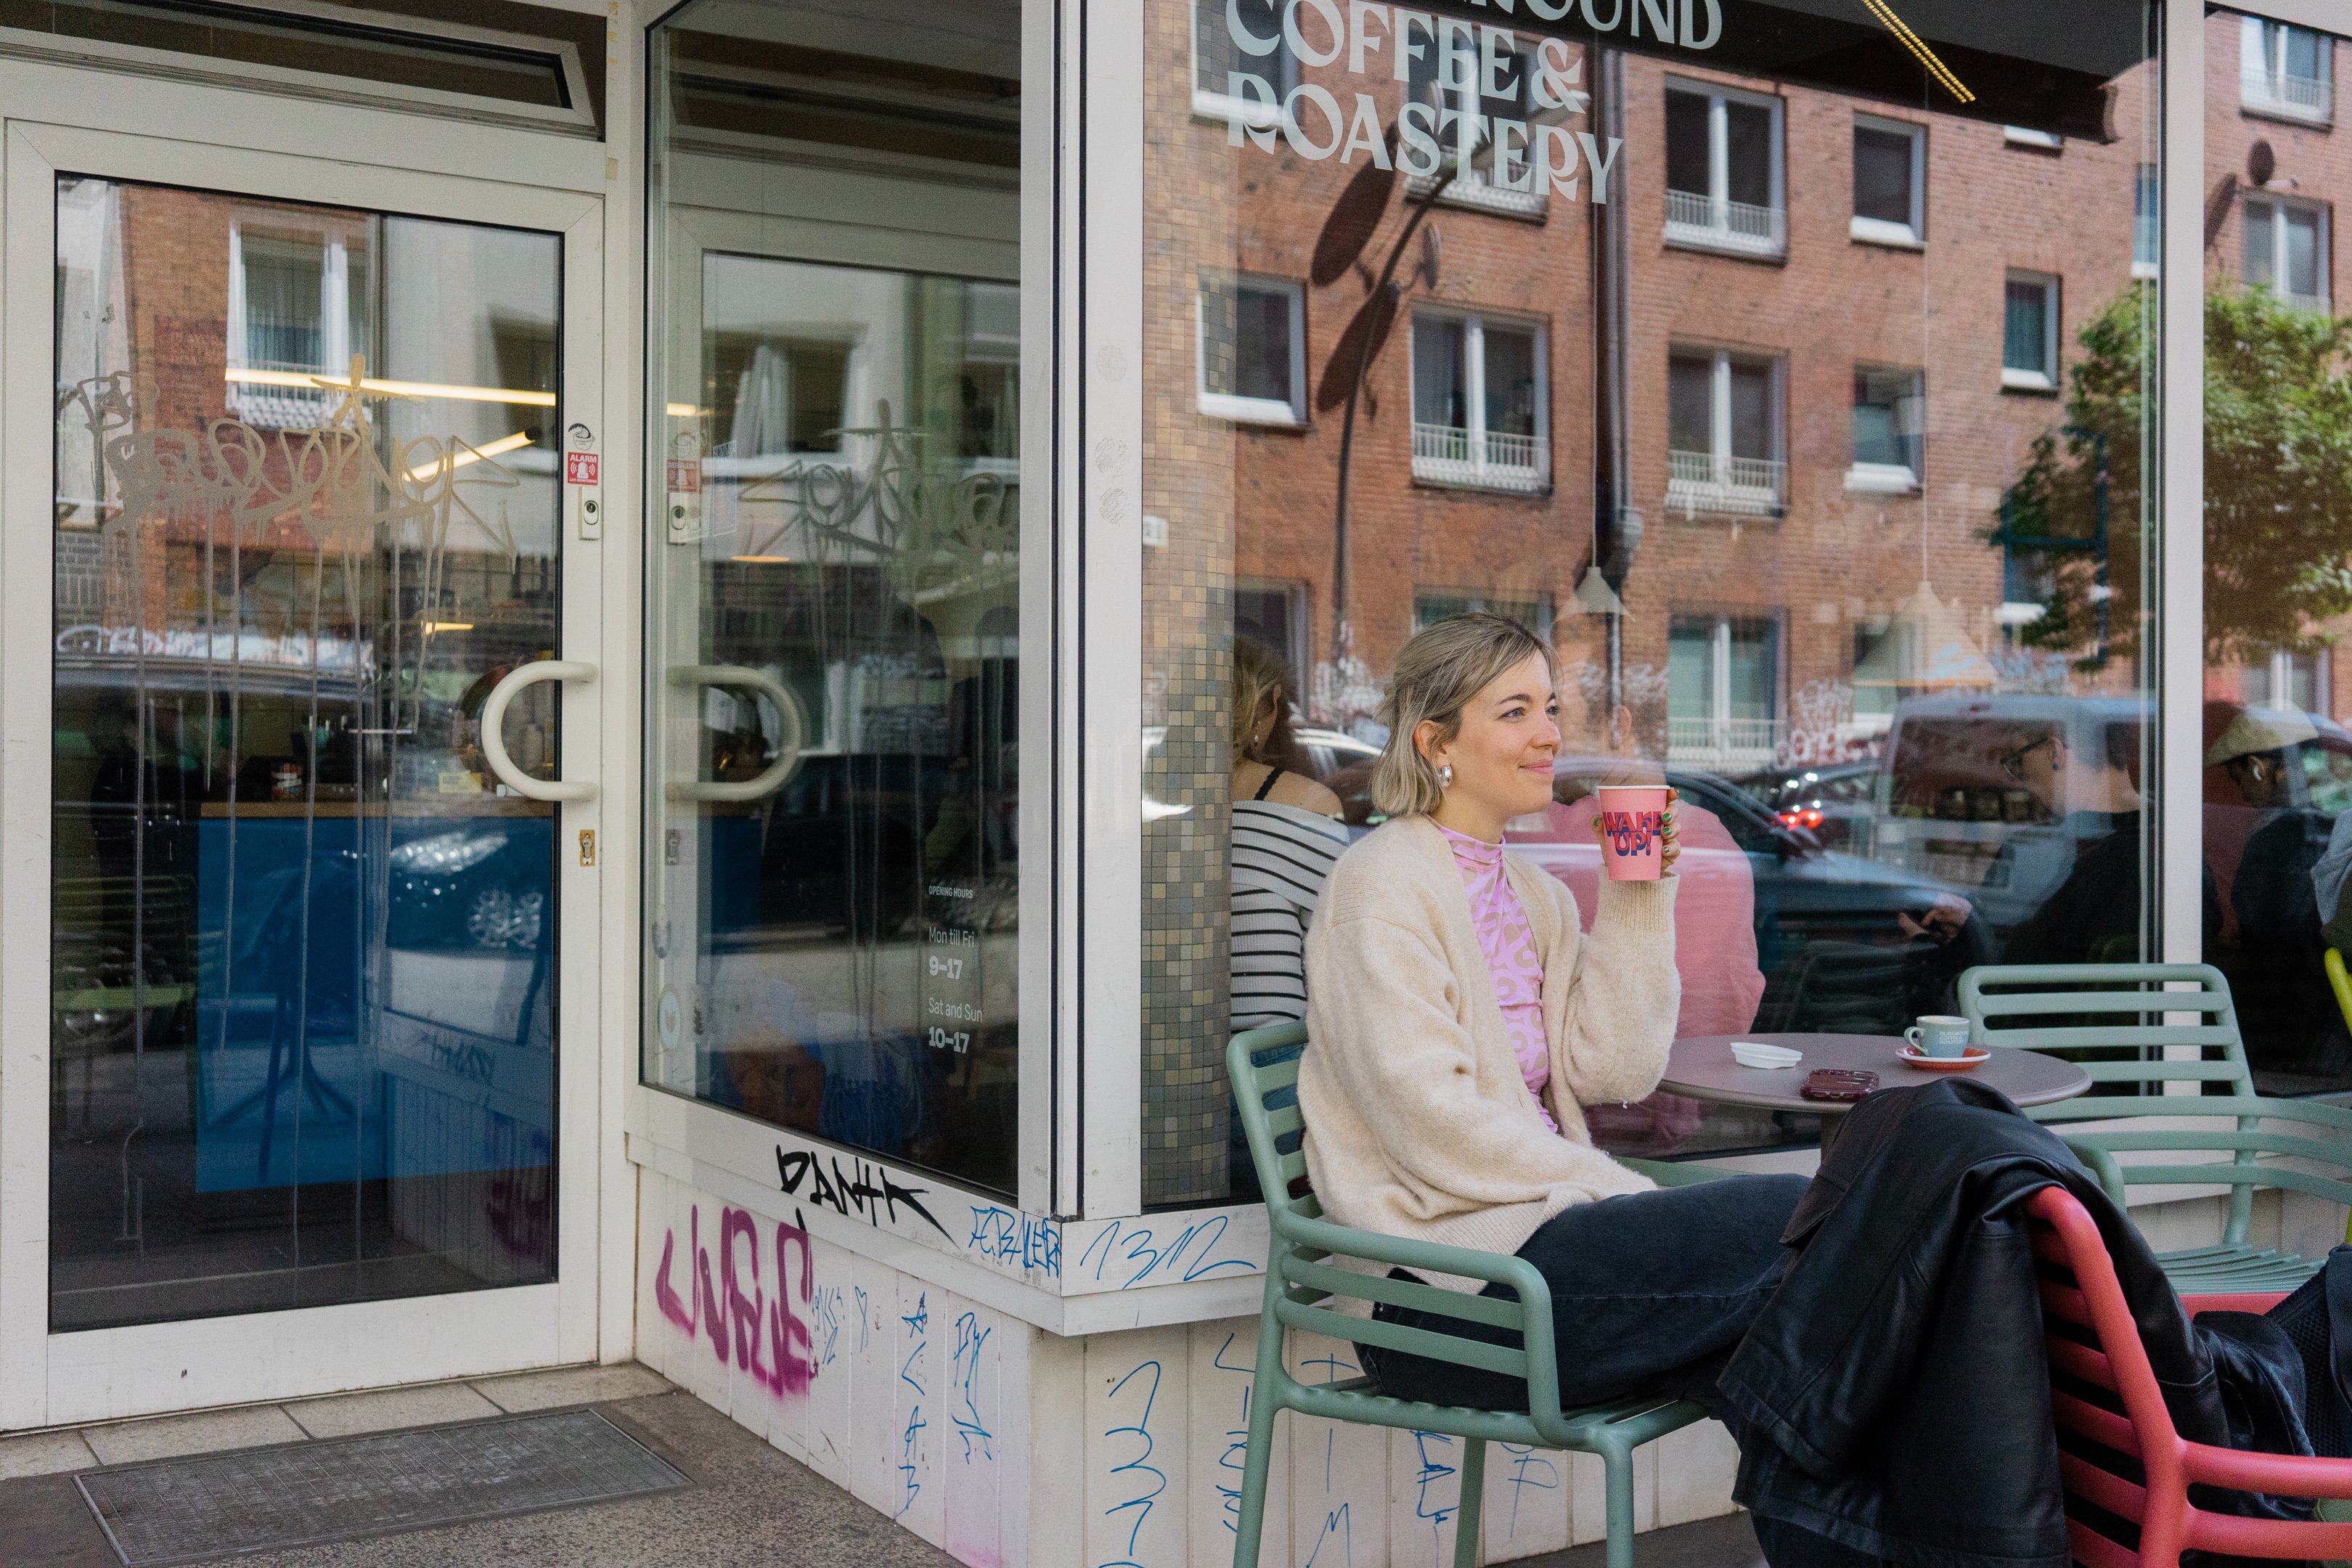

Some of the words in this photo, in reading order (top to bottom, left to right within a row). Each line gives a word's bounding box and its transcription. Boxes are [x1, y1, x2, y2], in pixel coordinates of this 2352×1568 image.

[1226, 0, 1519, 101] COFFEE
[1531, 37, 1585, 114] &
[1227, 71, 1623, 204] ROASTERY
[570, 454, 597, 463] ALARM
[1603, 811, 1662, 836] WAKE
[1614, 831, 1652, 856] UP!
[929, 885, 952, 897] OPENING
[953, 888, 973, 899] HOURS
[929, 926, 947, 944] Mon
[950, 928, 960, 947] till
[963, 931, 974, 948] Fri
[929, 997, 944, 1015] Sat
[945, 1003, 963, 1018] and
[965, 1004, 983, 1023] Sun
